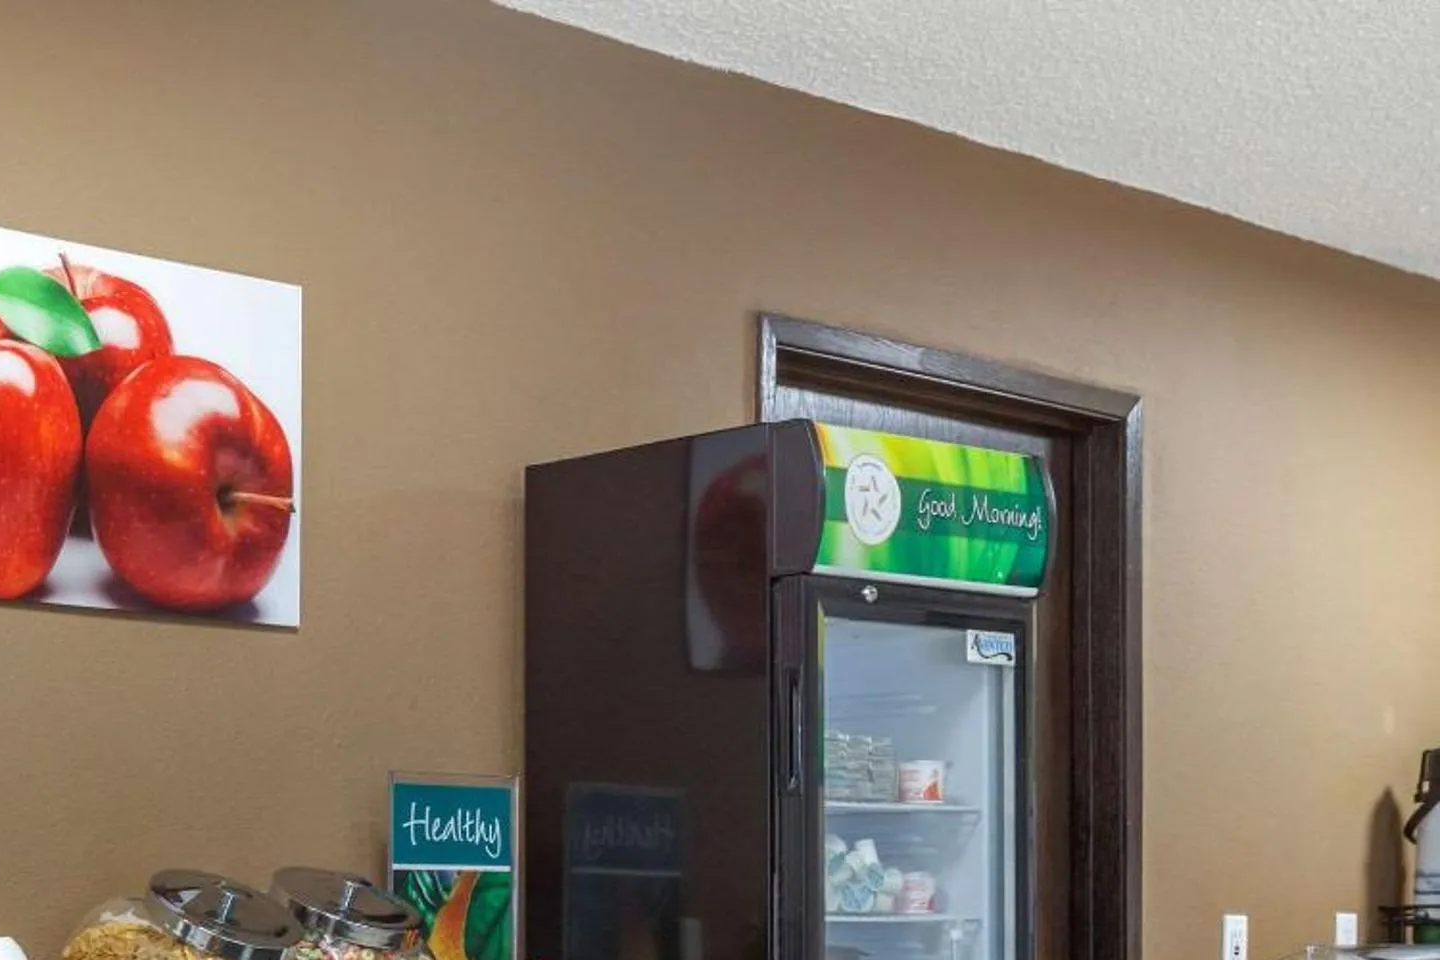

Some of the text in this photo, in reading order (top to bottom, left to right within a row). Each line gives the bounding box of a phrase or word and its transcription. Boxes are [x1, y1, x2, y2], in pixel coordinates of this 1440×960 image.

[917, 488, 1042, 541] Good Morning!
[402, 801, 502, 859] Healthy
